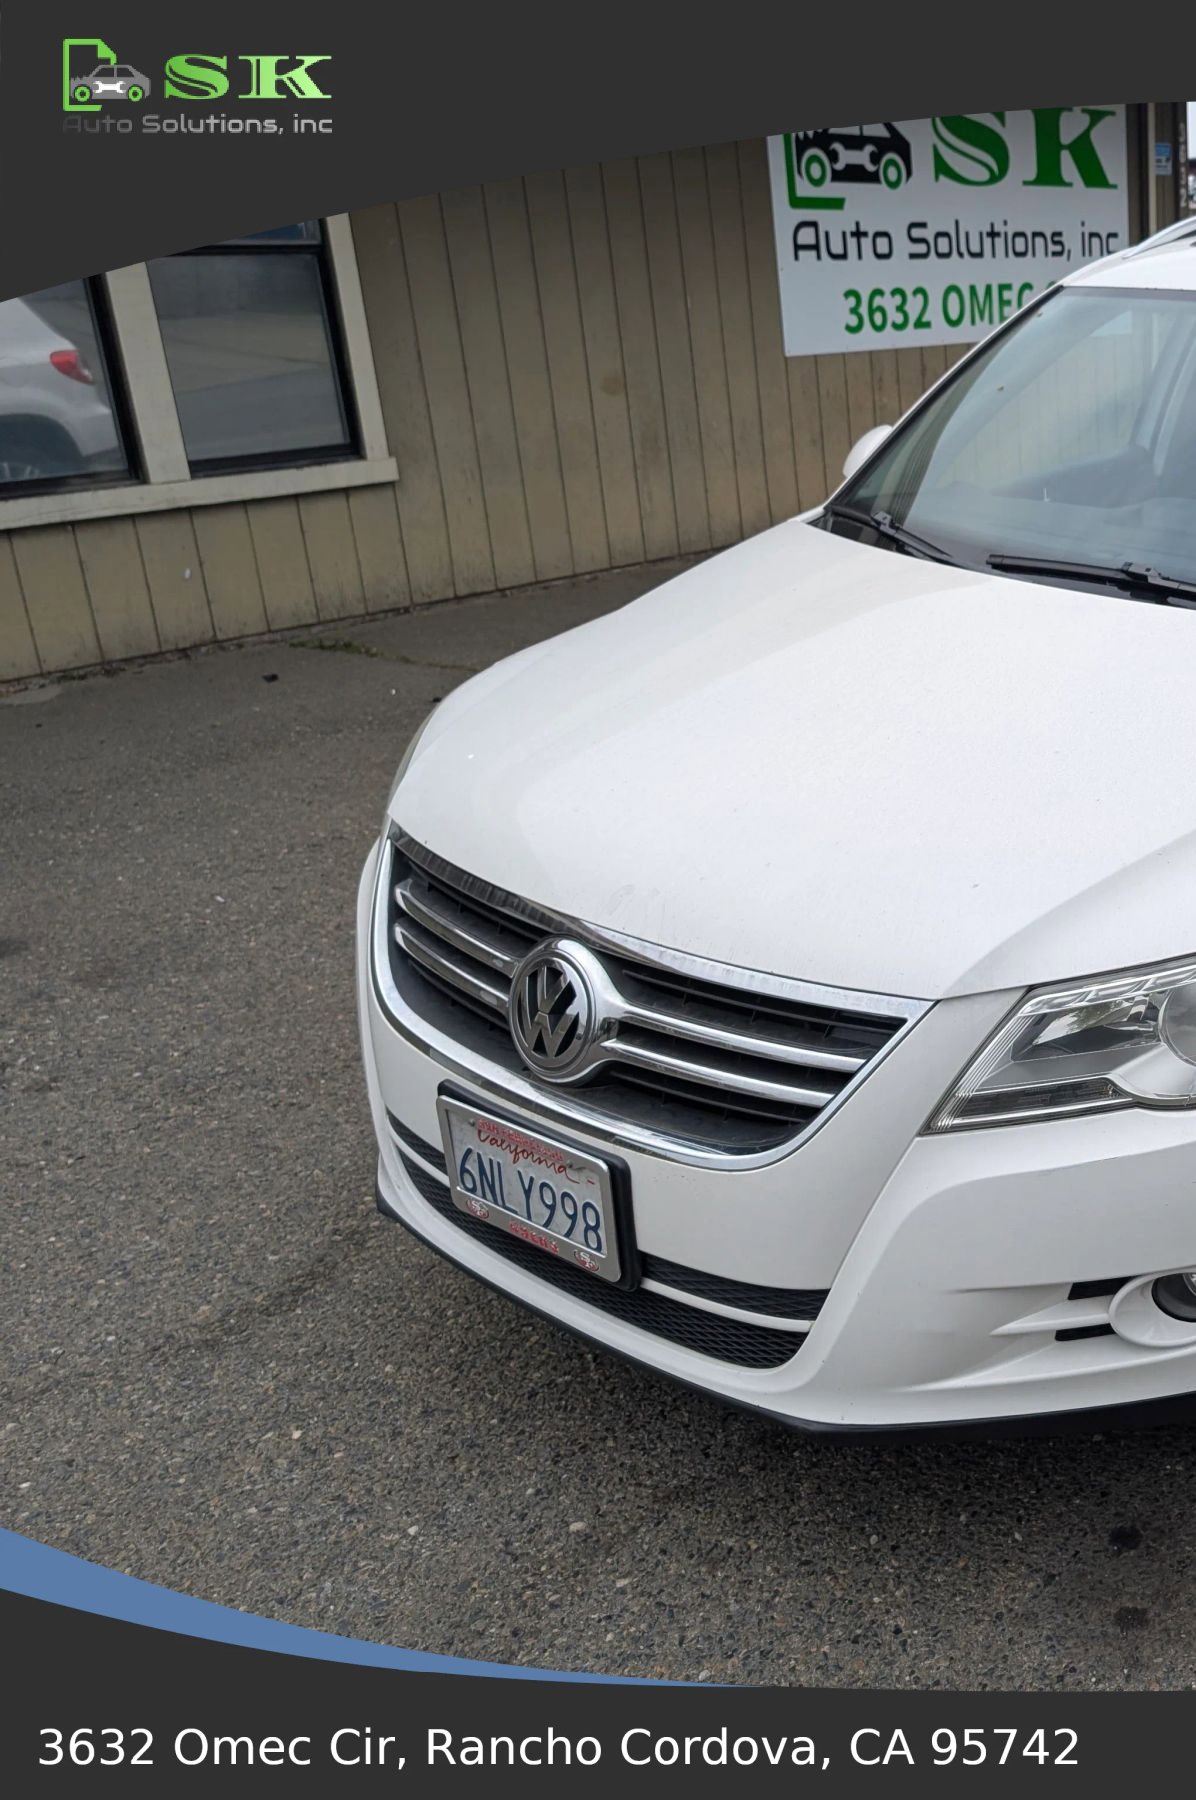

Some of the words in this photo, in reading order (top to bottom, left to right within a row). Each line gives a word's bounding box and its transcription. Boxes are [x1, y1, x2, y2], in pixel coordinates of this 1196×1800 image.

[931, 105, 1119, 190] SK
[792, 220, 894, 262] Auto
[907, 218, 1073, 263] Solutions,
[1080, 219, 1119, 259] inc
[842, 286, 932, 335] 3632
[458, 1146, 604, 1253] 6NLY998
